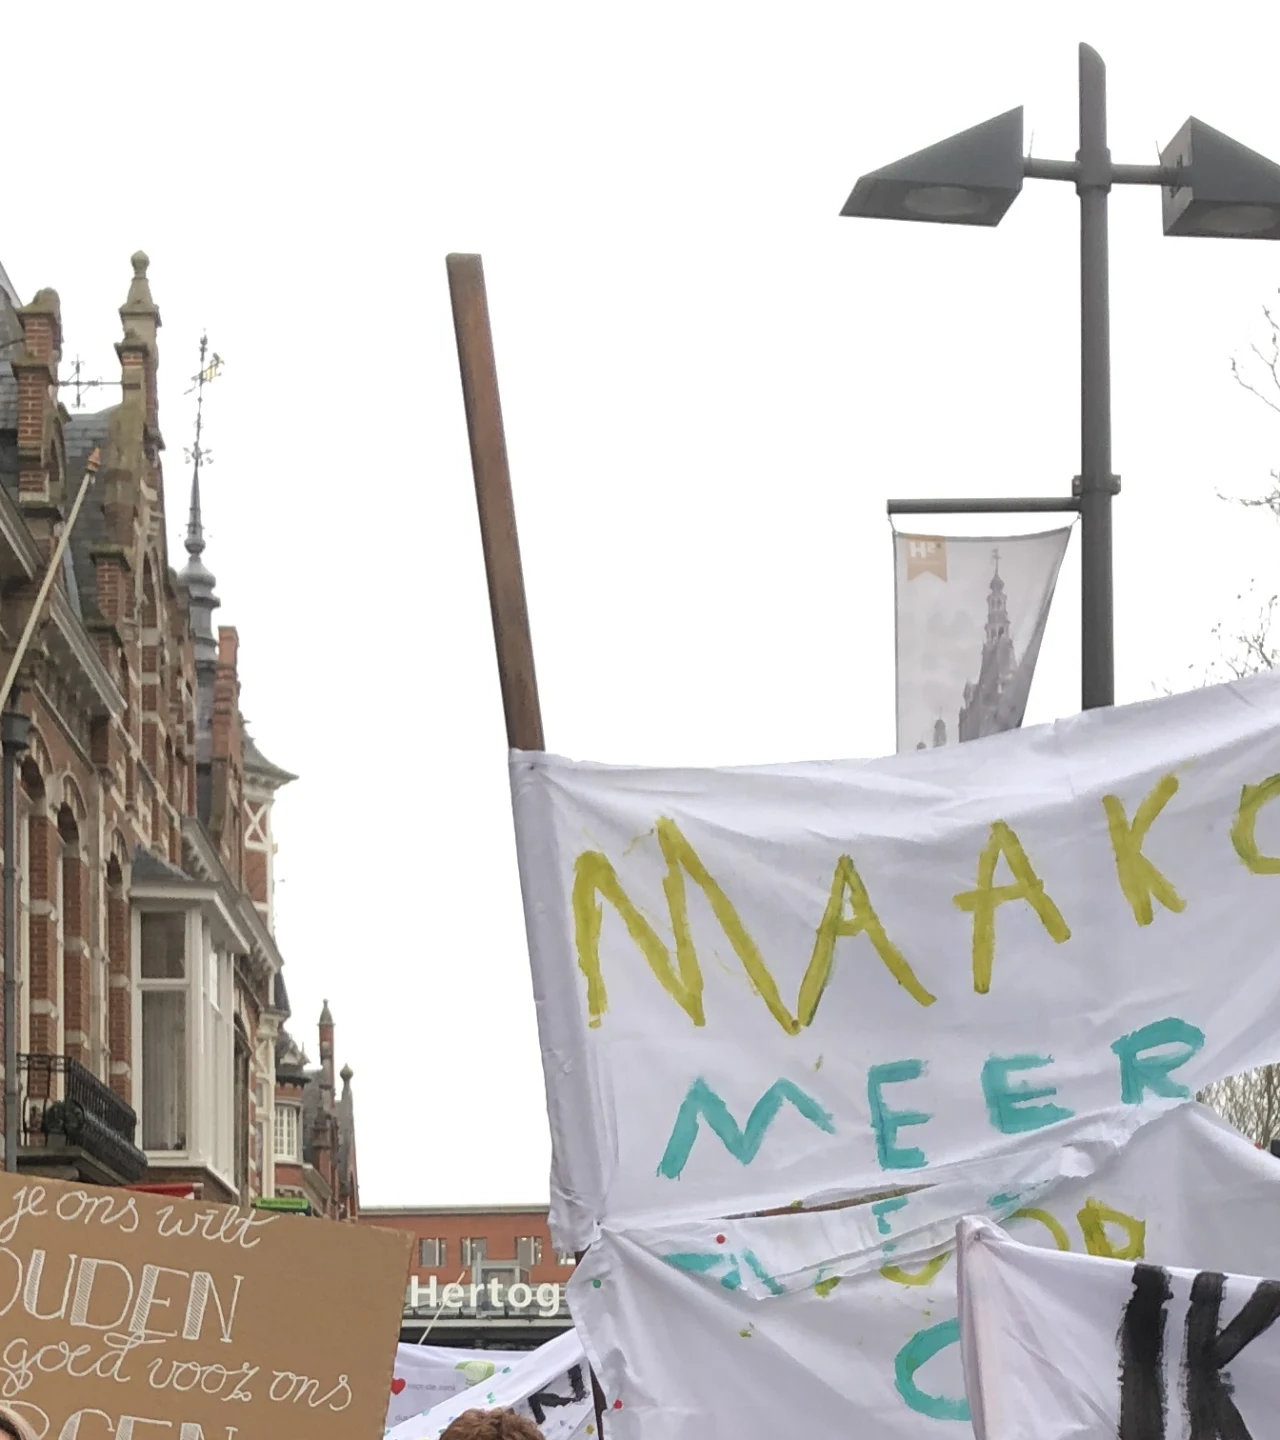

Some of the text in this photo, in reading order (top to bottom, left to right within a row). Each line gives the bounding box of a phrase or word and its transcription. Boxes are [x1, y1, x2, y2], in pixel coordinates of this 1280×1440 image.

[657, 1017, 1205, 1180] MEER
[56, 1187, 140, 1233] ons
[156, 1204, 279, 1248] wilt
[269, 1368, 354, 1411] ons
